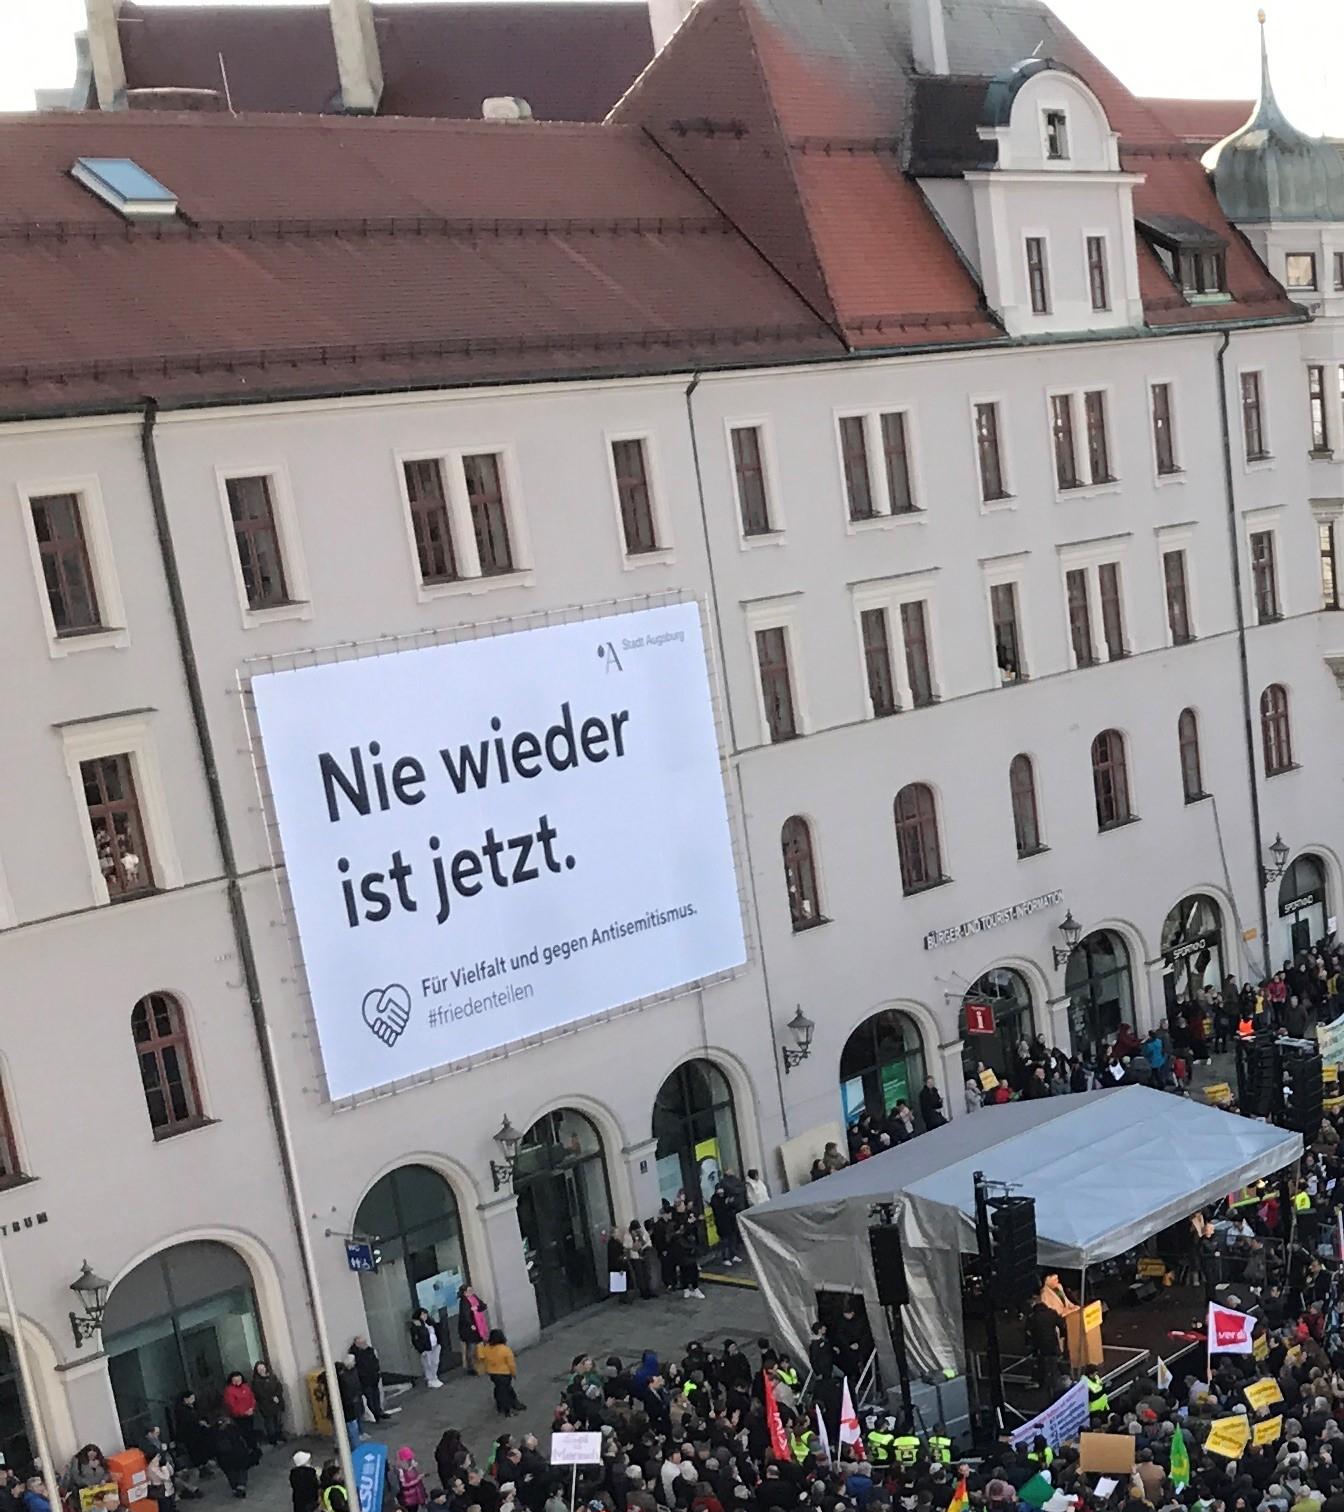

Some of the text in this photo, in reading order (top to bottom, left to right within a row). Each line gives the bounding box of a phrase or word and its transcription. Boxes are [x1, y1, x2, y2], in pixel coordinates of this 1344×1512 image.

[318, 702, 630, 823] Nie wieder
[337, 815, 577, 928] ist jetzt.
[421, 903, 698, 998] Für Vielfalt und gegen Antisemitismus.
[428, 981, 534, 1028] #friedenteilen
